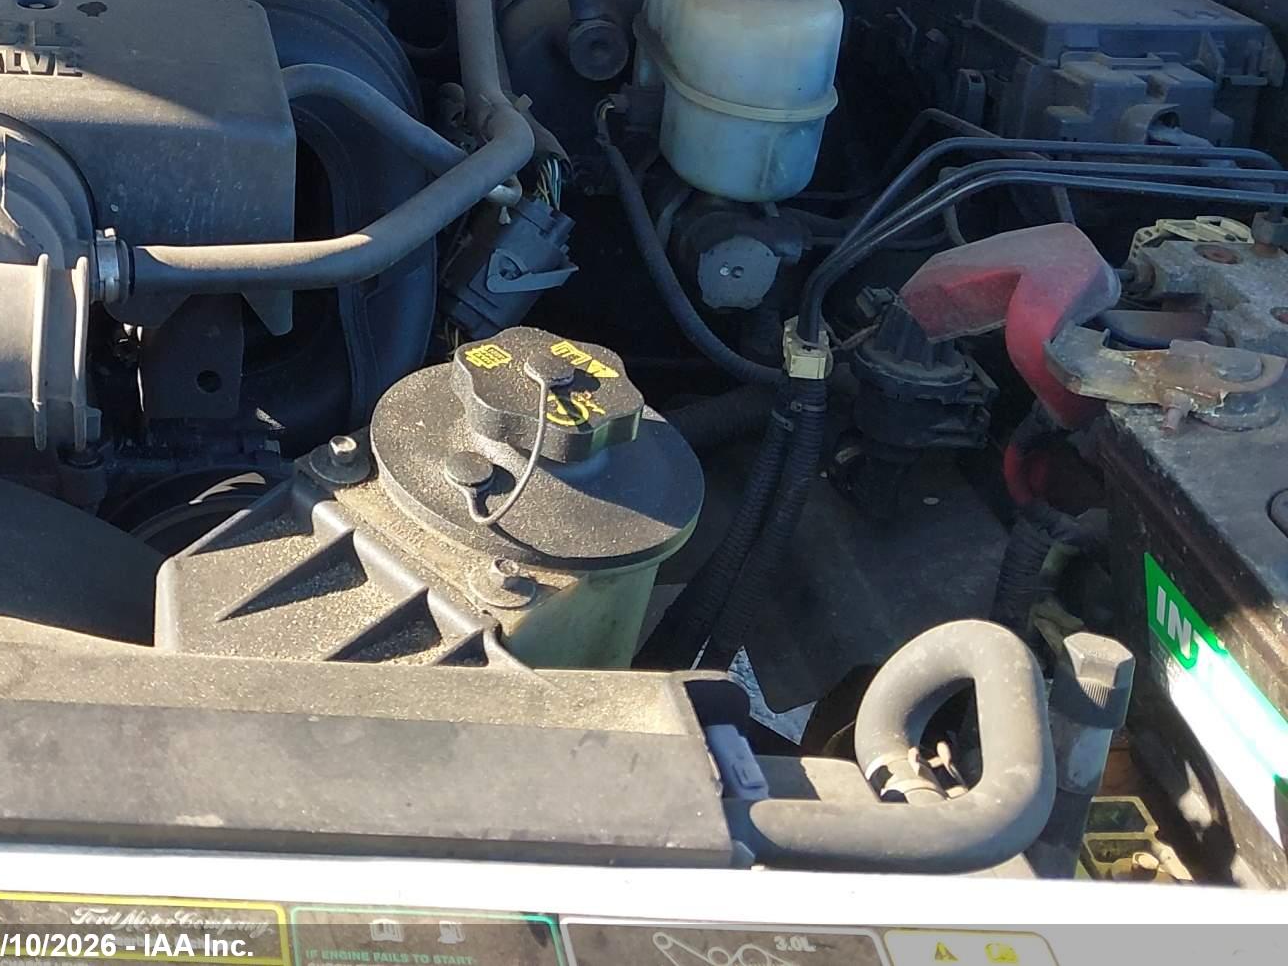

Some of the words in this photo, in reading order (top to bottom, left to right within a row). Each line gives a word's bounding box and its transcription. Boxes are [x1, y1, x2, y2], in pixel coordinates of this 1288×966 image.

[70, 907, 121, 926] Ford
[306, 949, 318, 960] IF
[321, 950, 370, 962] ENGINE
[373, 951, 409, 964] FAILS
[413, 953, 430, 964] TO
